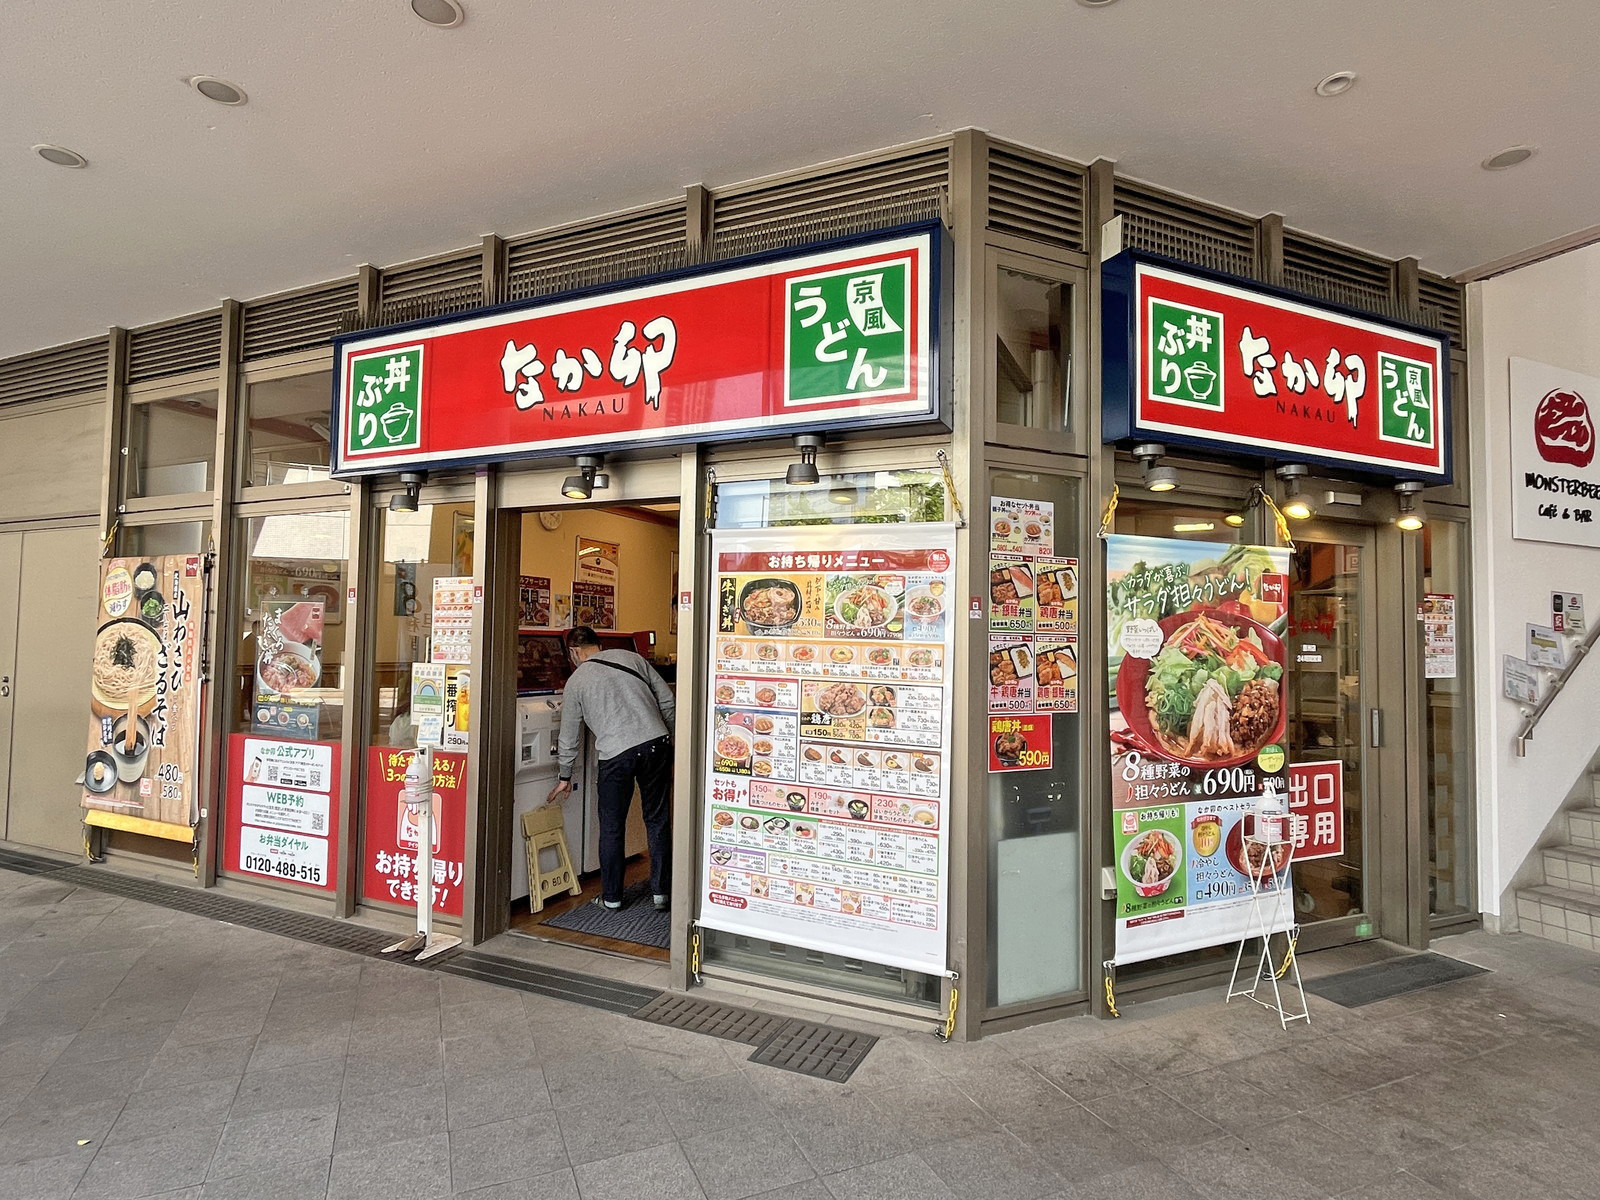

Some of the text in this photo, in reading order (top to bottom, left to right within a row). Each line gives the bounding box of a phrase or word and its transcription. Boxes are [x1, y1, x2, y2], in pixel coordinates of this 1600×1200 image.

[852, 279, 887, 331] 京風
[793, 287, 889, 392] うどん
[501, 316, 678, 411] なか卯
[1239, 326, 1367, 430] なか卯
[542, 398, 625, 423] NAKAU
[1276, 401, 1336, 425] NAKAU
[1384, 360, 1426, 441] うどん
[1562, 508, 1571, 520] &
[1573, 508, 1593, 523] BAR
[768, 554, 885, 569] お持ち帰りメニュー
[1126, 563, 1185, 588] カラダが喜ぶ
[721, 579, 736, 632] 牛すき丼
[446, 676, 459, 728] 一番搾り
[276, 745, 315, 760] 公式アプリ
[1018, 750, 1050, 767] 590円
[1121, 750, 1191, 782] 8種野菜の
[713, 779, 737, 789] セットも
[713, 787, 741, 803] お得!
[1135, 780, 1191, 801] 担々うどん
[1203, 767, 1256, 797] 690円
[1289, 773, 1335, 809] 出口
[266, 791, 305, 808] WEB予約
[259, 833, 309, 851] お弁当ダイヤル
[1289, 810, 1336, 849] 専用
[245, 855, 321, 883] 0120-489-515
[375, 849, 464, 888] お持帰り
[1196, 869, 1235, 883] 担々うどん
